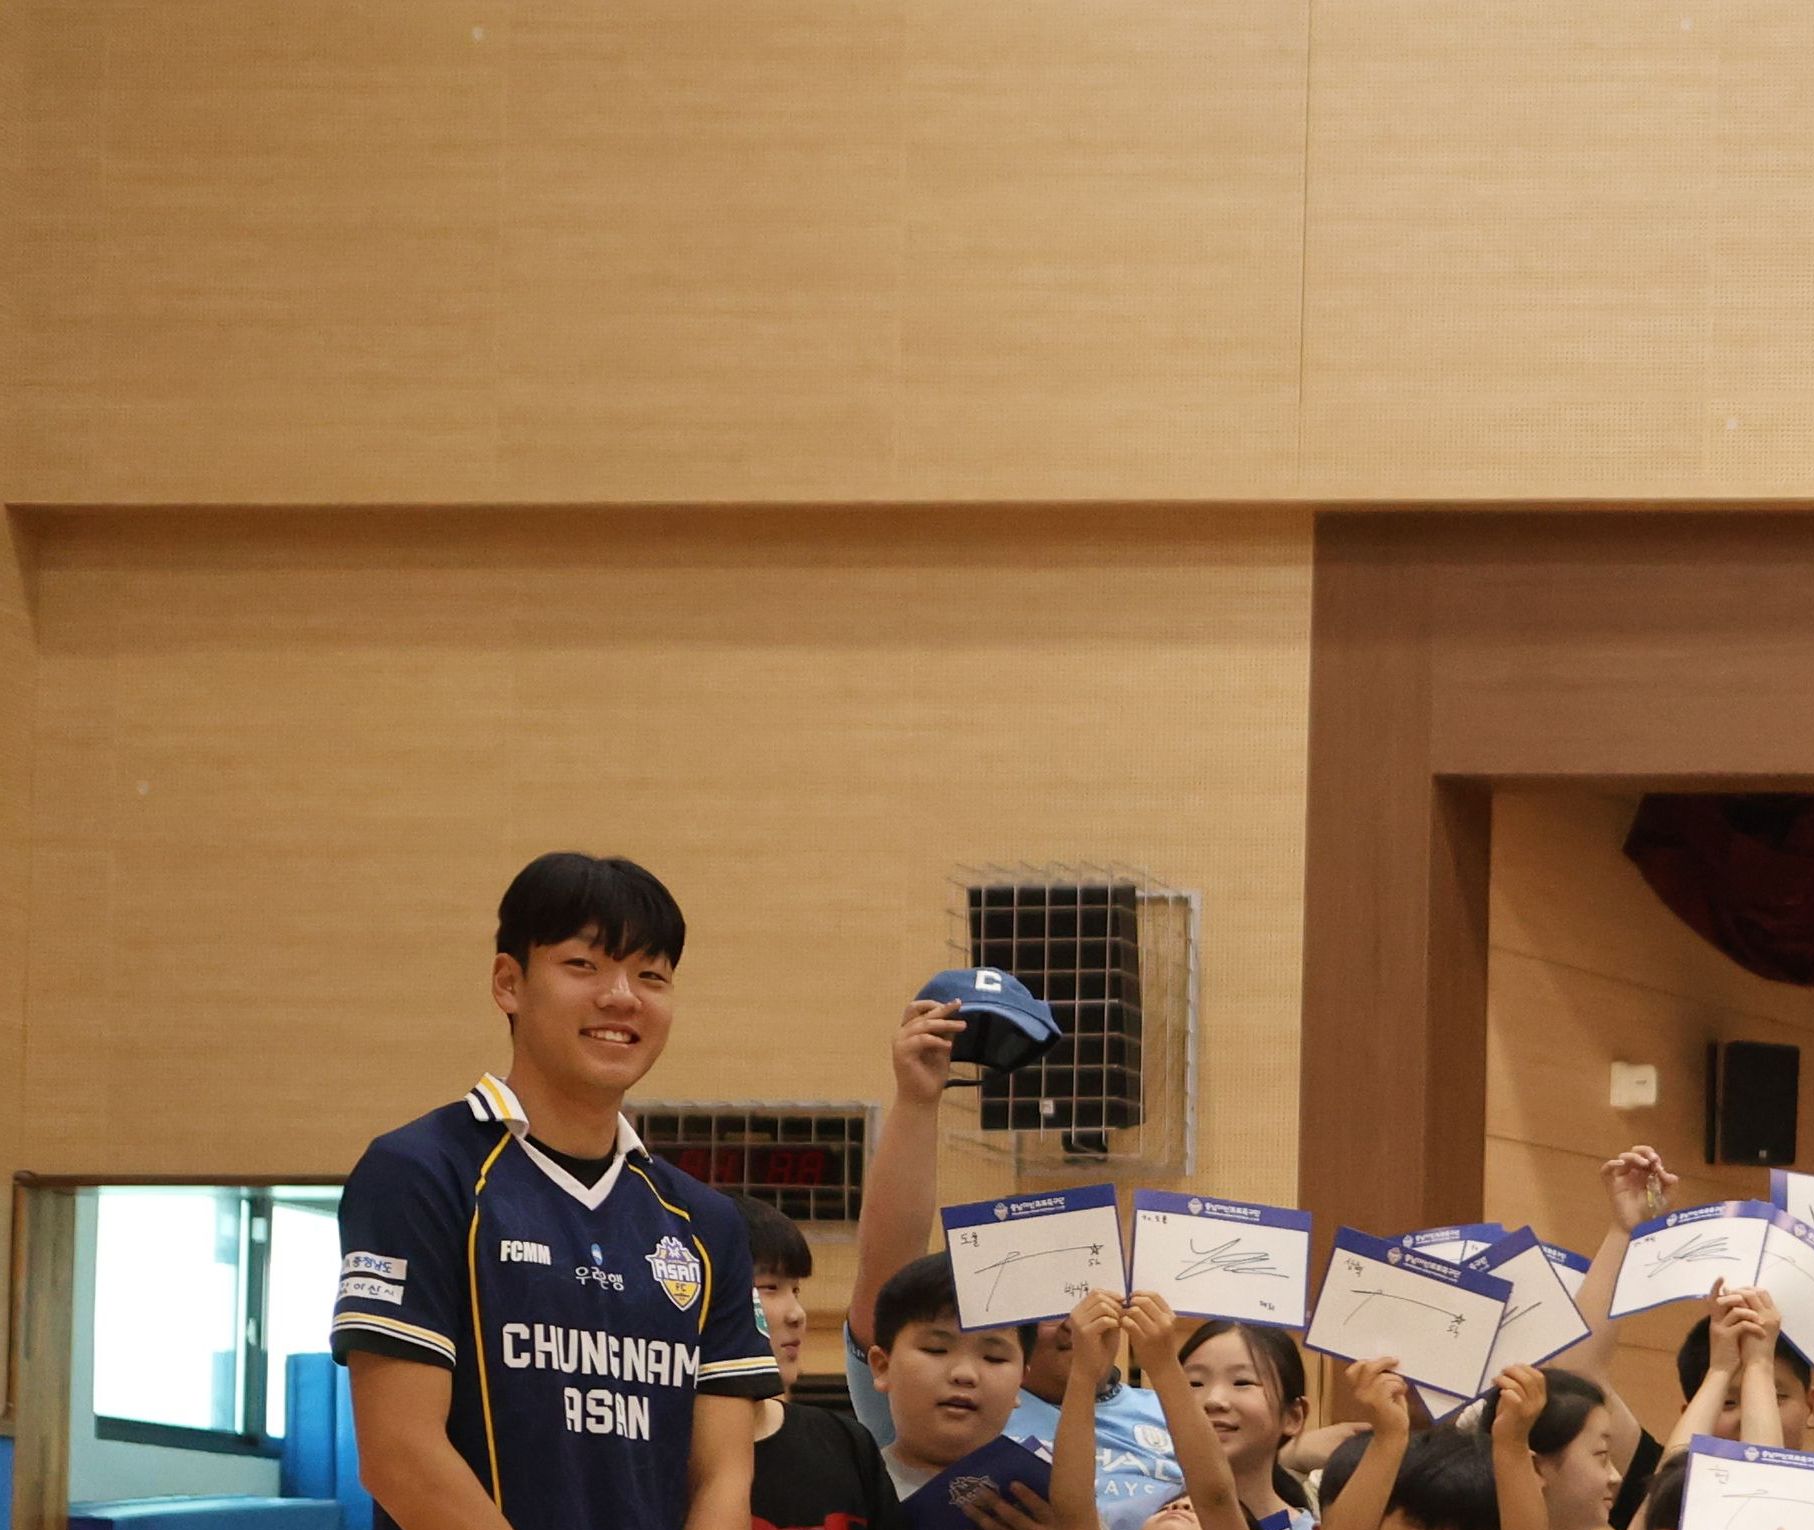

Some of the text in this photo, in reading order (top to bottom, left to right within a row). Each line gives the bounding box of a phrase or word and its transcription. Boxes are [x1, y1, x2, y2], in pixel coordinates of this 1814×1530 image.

[500, 1240, 551, 1265] FCMM
[655, 1260, 700, 1282] ASAN
[502, 1323, 700, 1390] CHUNGNAM
[564, 1387, 650, 1441] ASAN
